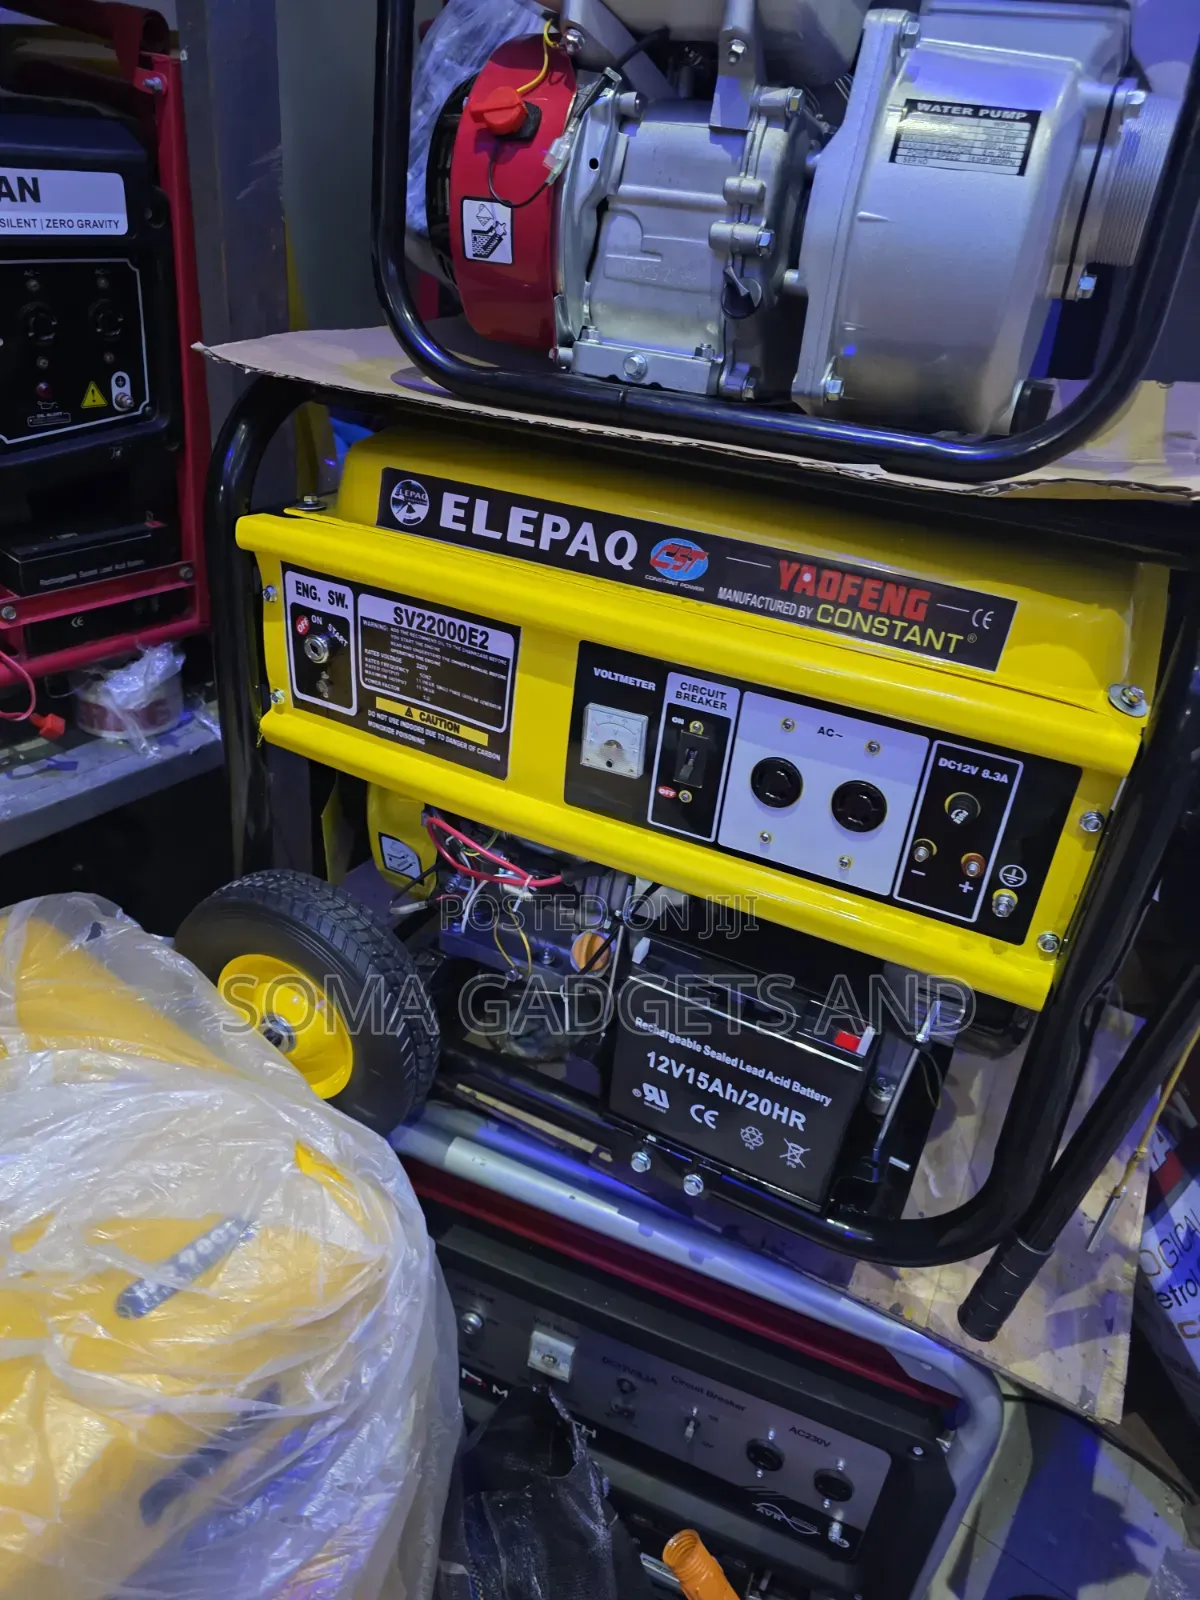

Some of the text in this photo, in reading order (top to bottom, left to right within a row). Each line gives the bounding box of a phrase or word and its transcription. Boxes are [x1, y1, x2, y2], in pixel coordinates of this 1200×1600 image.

[916, 102, 1028, 120] WATER PUMP
[0, 175, 41, 203] AN
[0, 218, 120, 229] SILENT ZERO GRAVITY
[439, 492, 638, 571] ELEPAQ
[295, 580, 349, 610] ENG. SW.
[644, 574, 705, 592] CONSTANT POWER
[778, 559, 932, 622] YAOFENG
[296, 617, 309, 634] OFF
[311, 614, 323, 626] ON
[393, 606, 490, 650] SV22000E2
[717, 586, 964, 654] MANUFACTURED BY CONSTANT
[327, 623, 349, 648] START
[593, 667, 656, 692] VOLTMETER
[680, 681, 727, 700] CIRCUIT
[675, 690, 728, 711] BREAKER
[367, 720, 426, 746] MONOXIDE POISONING
[419, 711, 461, 735] CAUTION
[671, 716, 685, 725] ON
[367, 709, 501, 762] DO NOT USE INDOORS DUE TO DANGER OF CARBON
[938, 757, 1009, 785] DC12V 8.3A
[658, 787, 676, 798] OFF
[635, 1016, 833, 1107] Rechargeable Sealed Lead Acid Battery
[646, 1051, 807, 1132] 12V15Ah/20HR
[671, 1375, 748, 1412] Circuit Breaker
